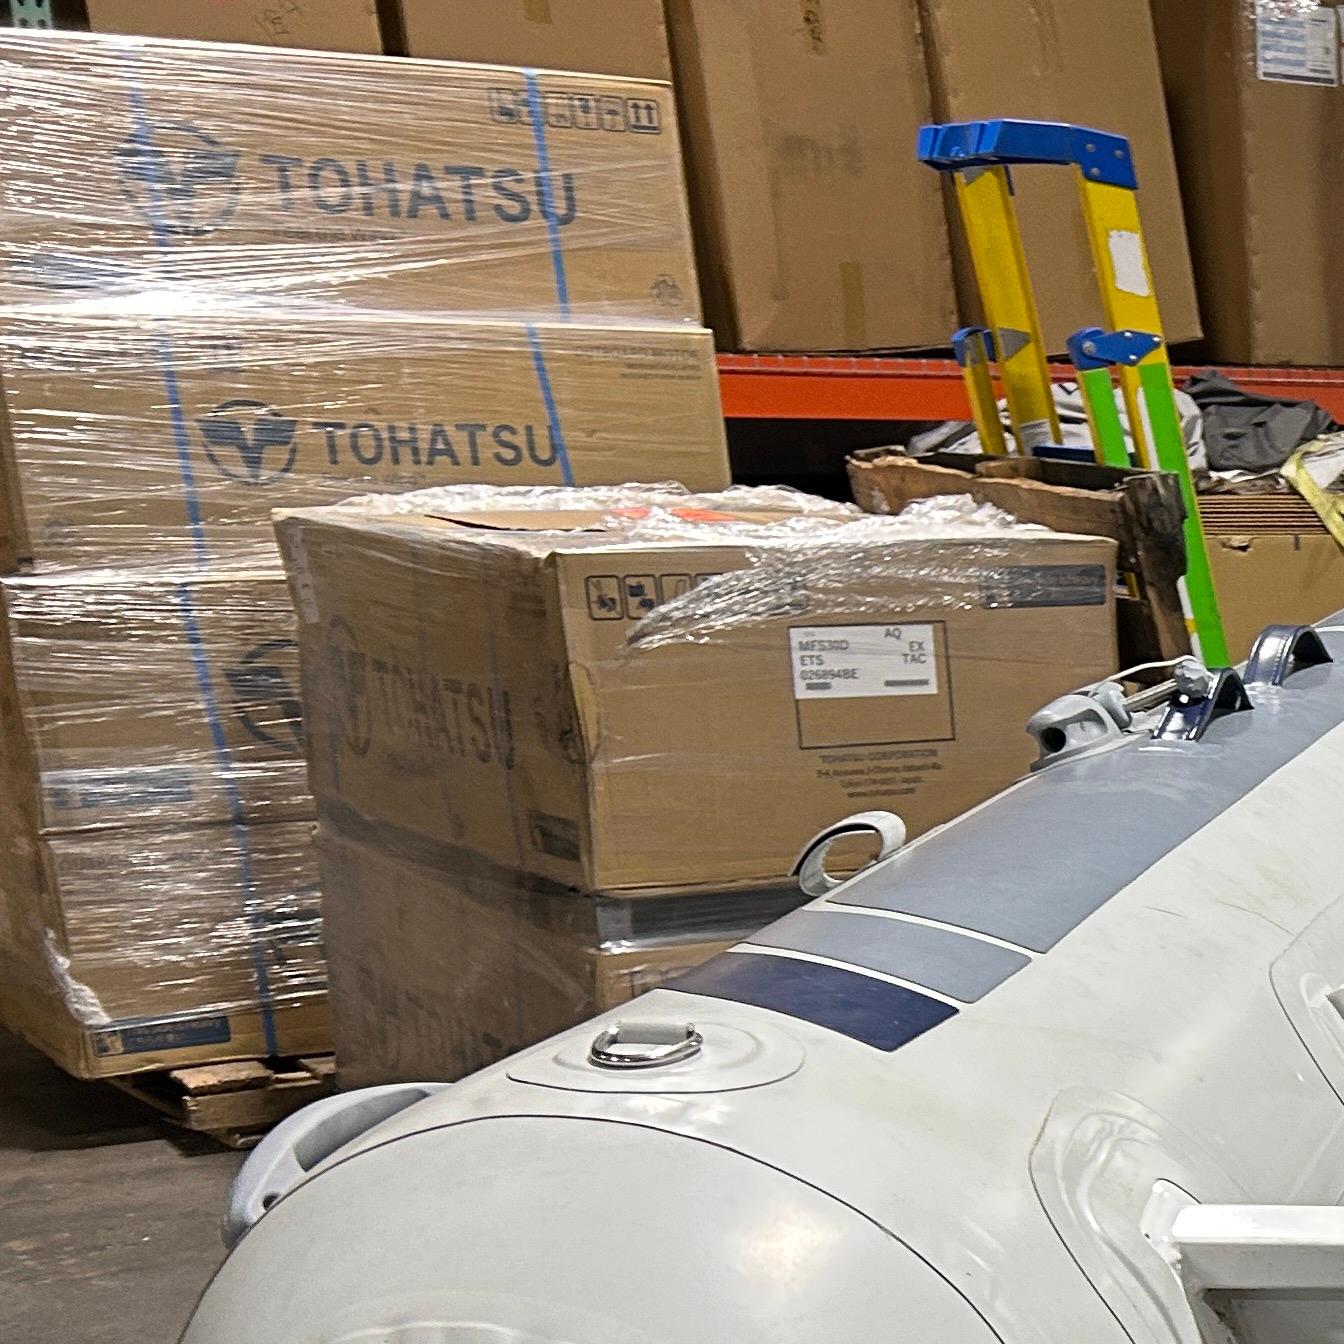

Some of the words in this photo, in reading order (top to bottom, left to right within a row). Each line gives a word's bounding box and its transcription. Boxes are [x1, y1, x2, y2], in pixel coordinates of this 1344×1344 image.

[259, 153, 577, 226] TOHATSU
[312, 420, 558, 467] TOHATSU
[884, 628, 902, 640] AQ
[909, 641, 925, 652] EX
[801, 655, 824, 666] ETS
[902, 653, 927, 664] TAC
